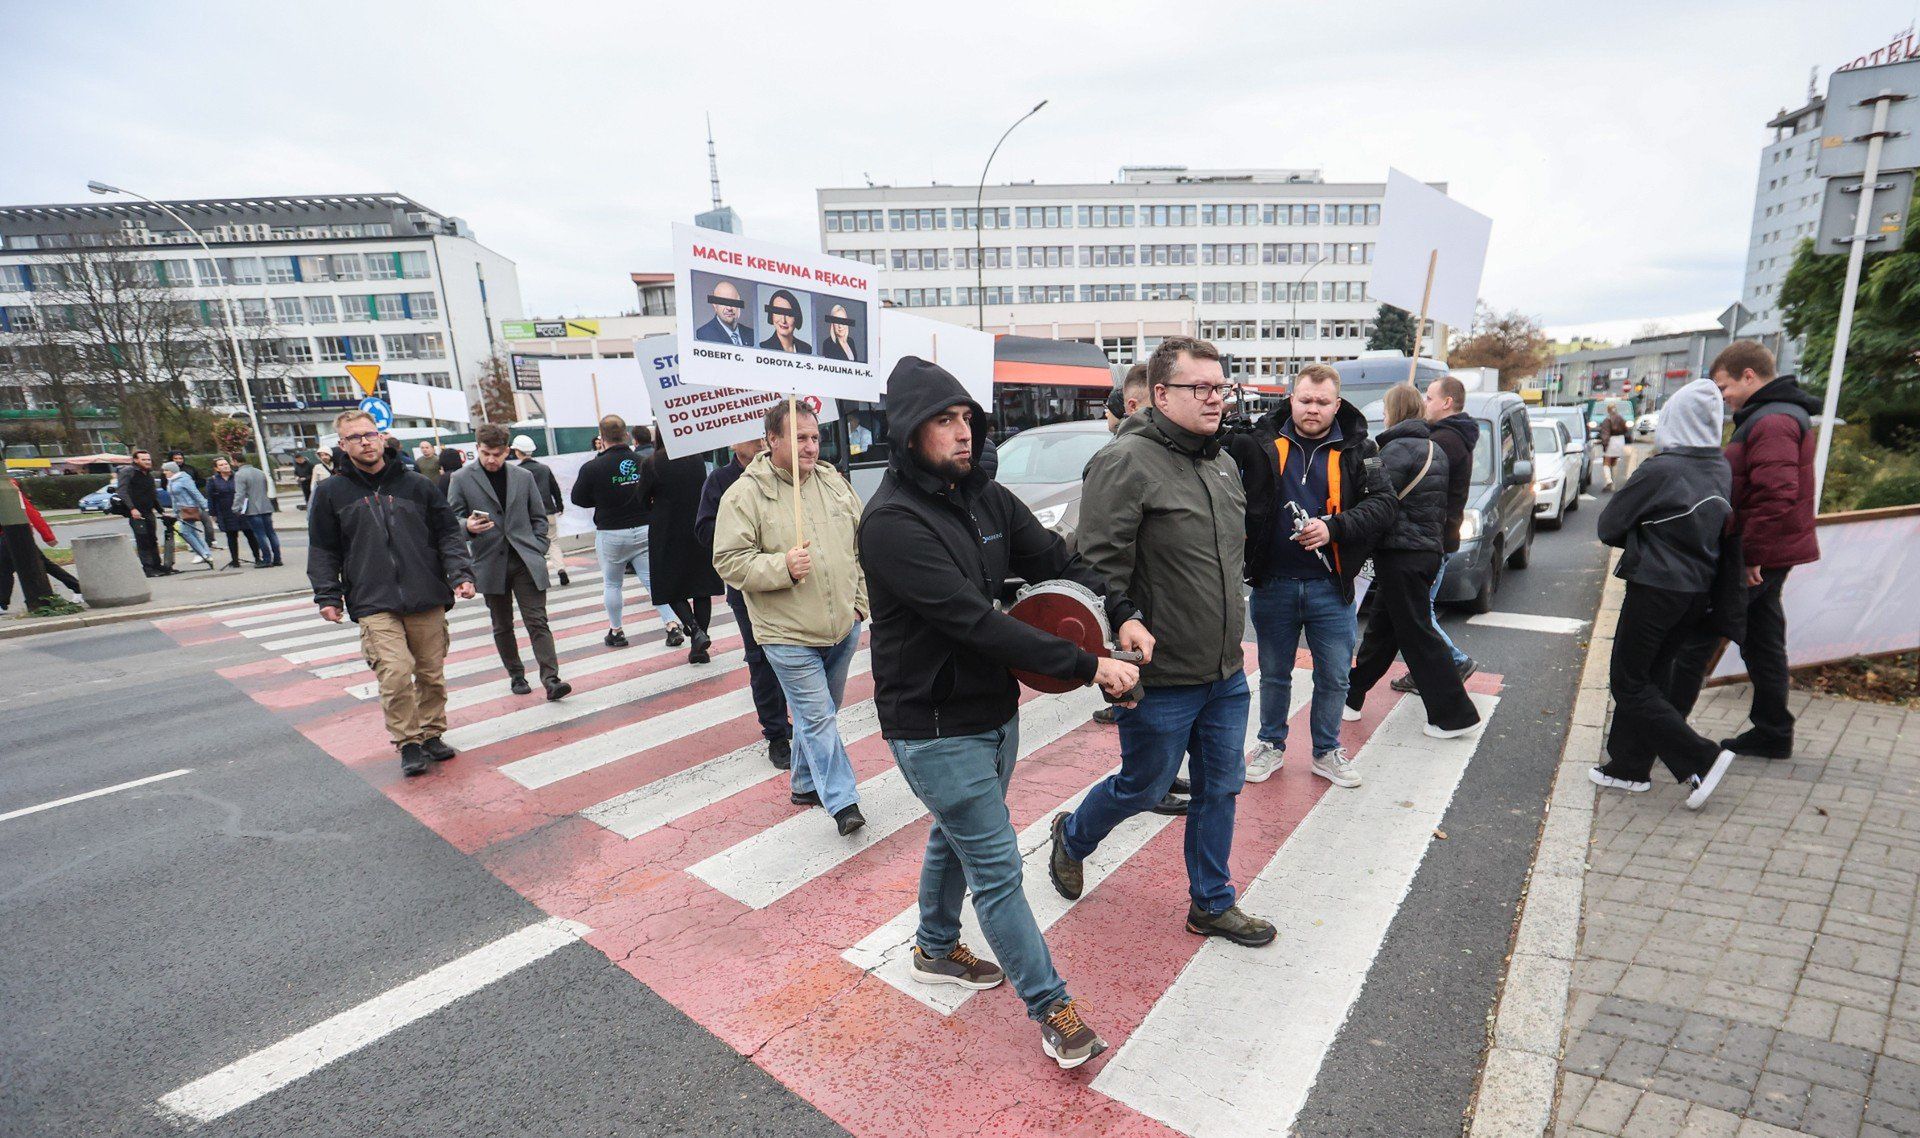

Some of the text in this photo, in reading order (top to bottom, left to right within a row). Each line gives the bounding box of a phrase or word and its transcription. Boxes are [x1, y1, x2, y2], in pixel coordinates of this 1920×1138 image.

[692, 244, 742, 266] MACIE
[814, 269, 867, 290] RĘKACH
[693, 348, 744, 361] ROBERT G.
[756, 356, 814, 370] DOROTA Z.-S.
[817, 364, 873, 377] PAULINA H.-K.
[664, 386, 753, 409] UZUPEŁNIE
[669, 391, 782, 423] DO UZUPEŁNIENIA
[673, 406, 772, 437] DO UZUPEŁNIE
